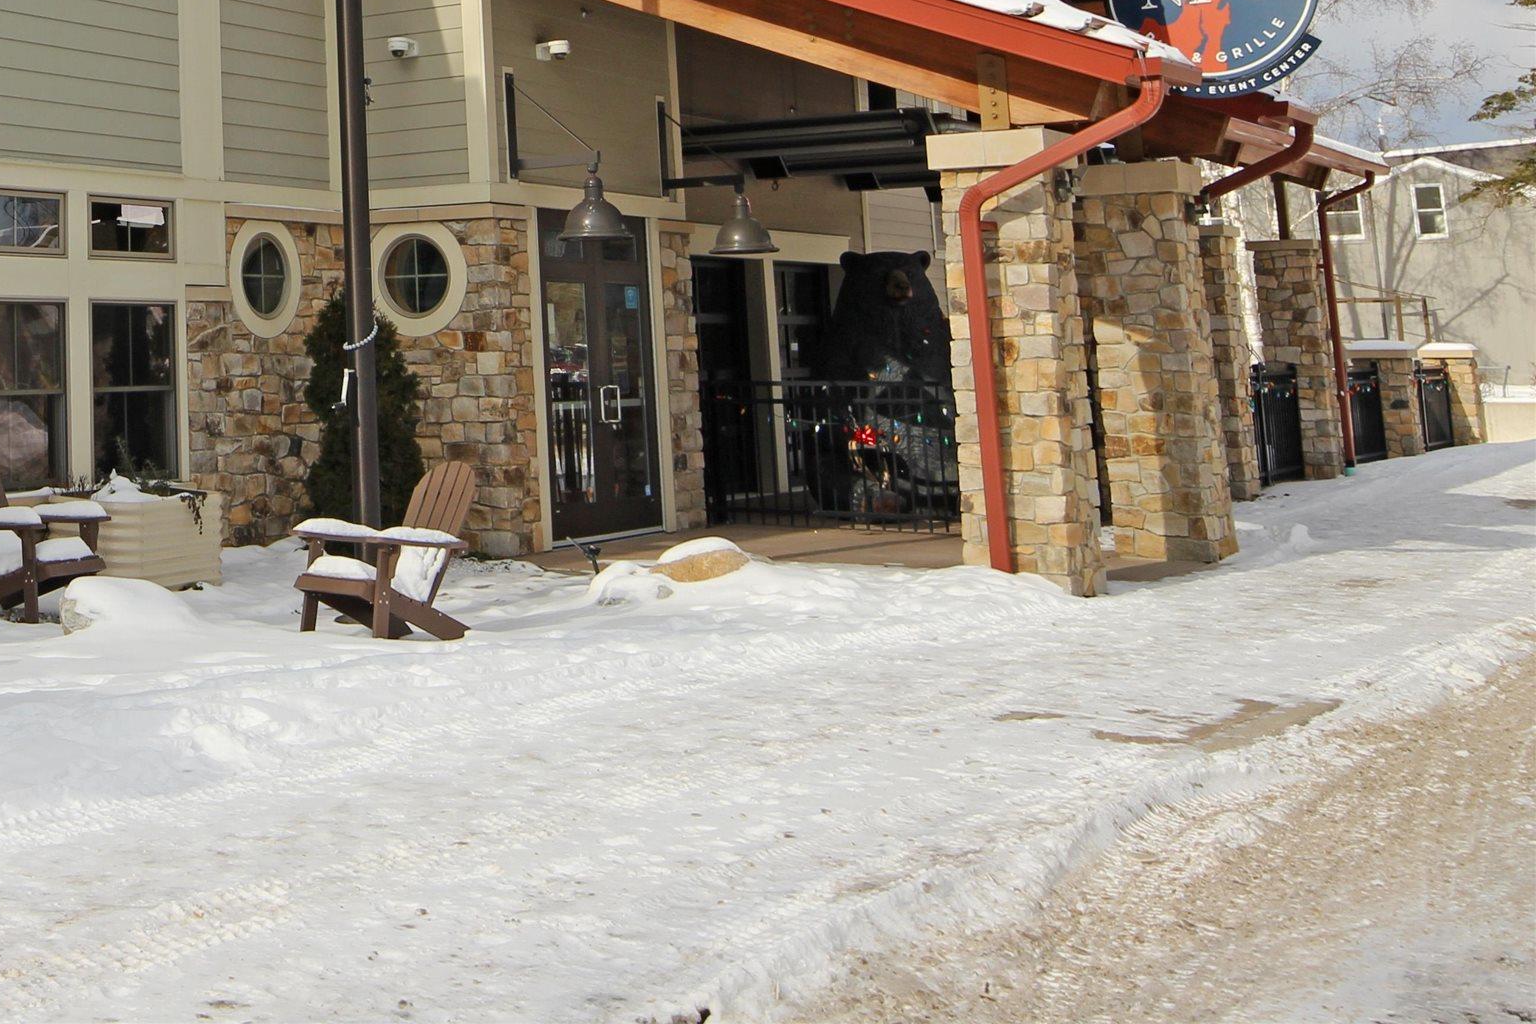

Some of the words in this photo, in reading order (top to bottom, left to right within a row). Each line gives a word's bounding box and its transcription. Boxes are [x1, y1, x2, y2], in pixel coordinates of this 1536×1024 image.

[1191, 52, 1202, 64] &
[1216, 17, 1285, 63] GRILLE
[1208, 78, 1256, 95] EVENT
[1263, 42, 1312, 82] CENTER
